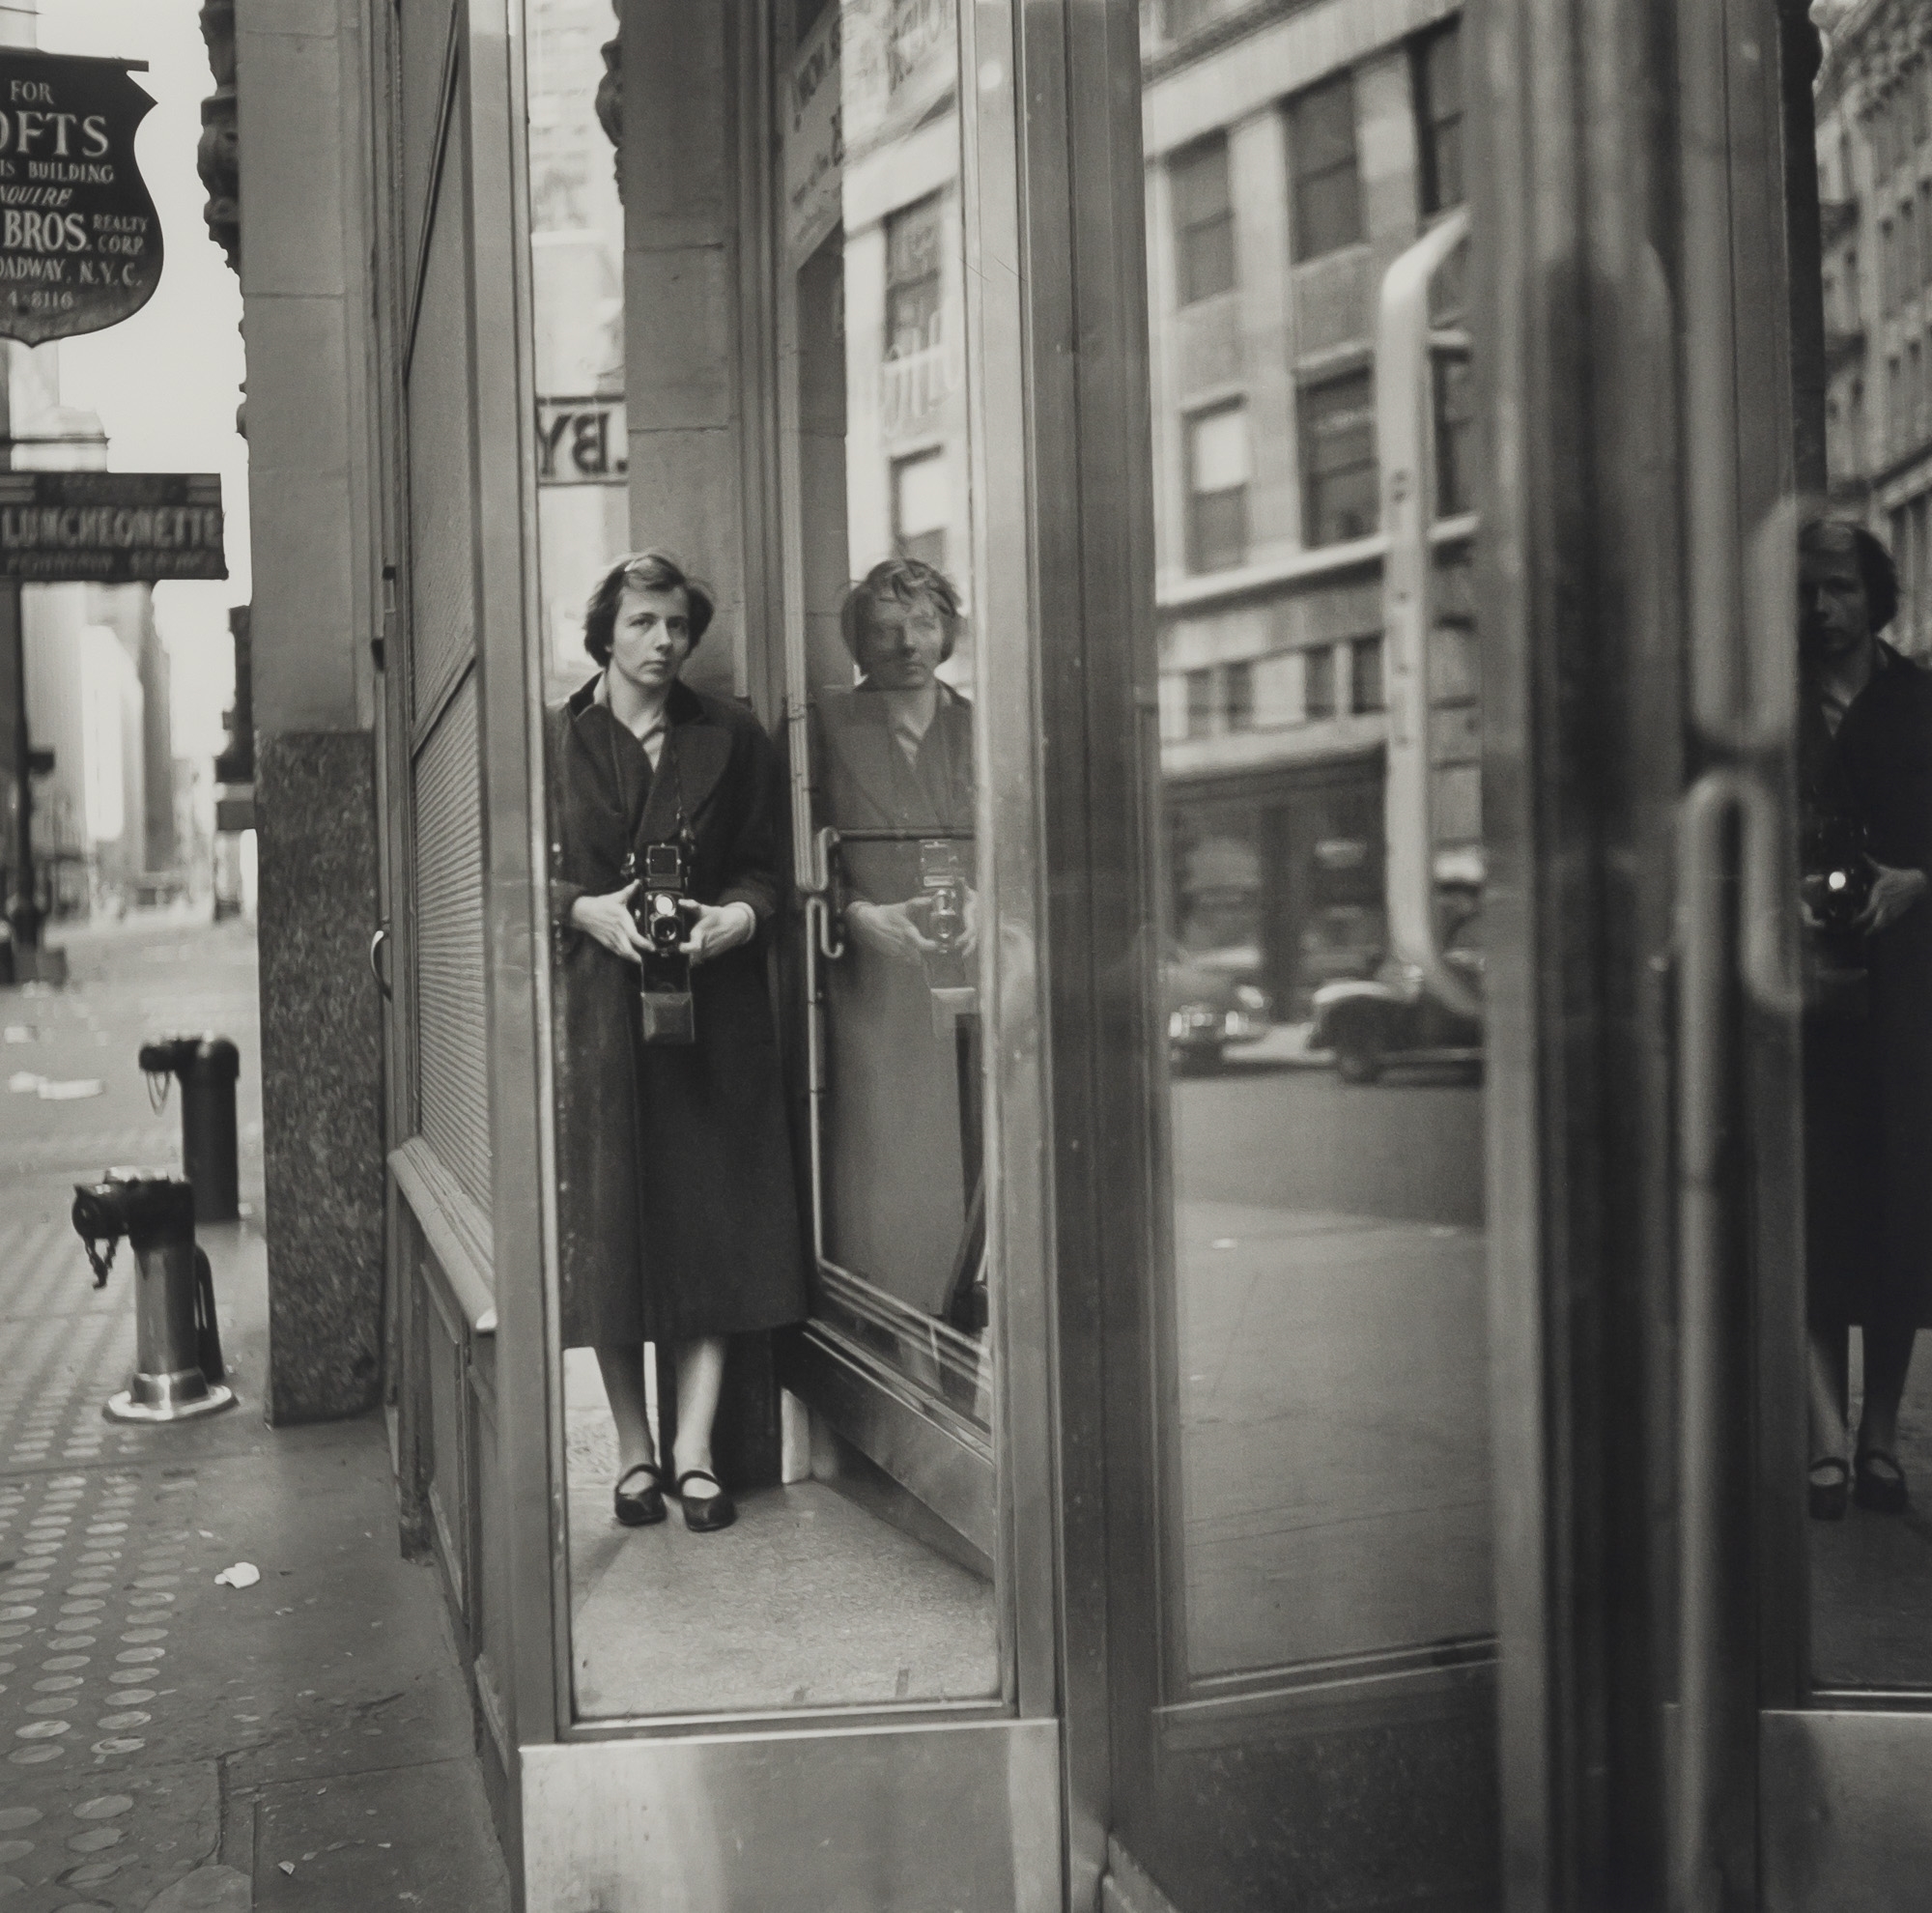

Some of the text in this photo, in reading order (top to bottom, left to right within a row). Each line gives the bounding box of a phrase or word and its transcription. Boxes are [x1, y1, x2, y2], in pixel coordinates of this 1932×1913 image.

[10, 79, 55, 104] FOR
[28, 159, 114, 184] BUILDING
[3, 210, 93, 253] BROS.
[94, 214, 148, 233] REALTY
